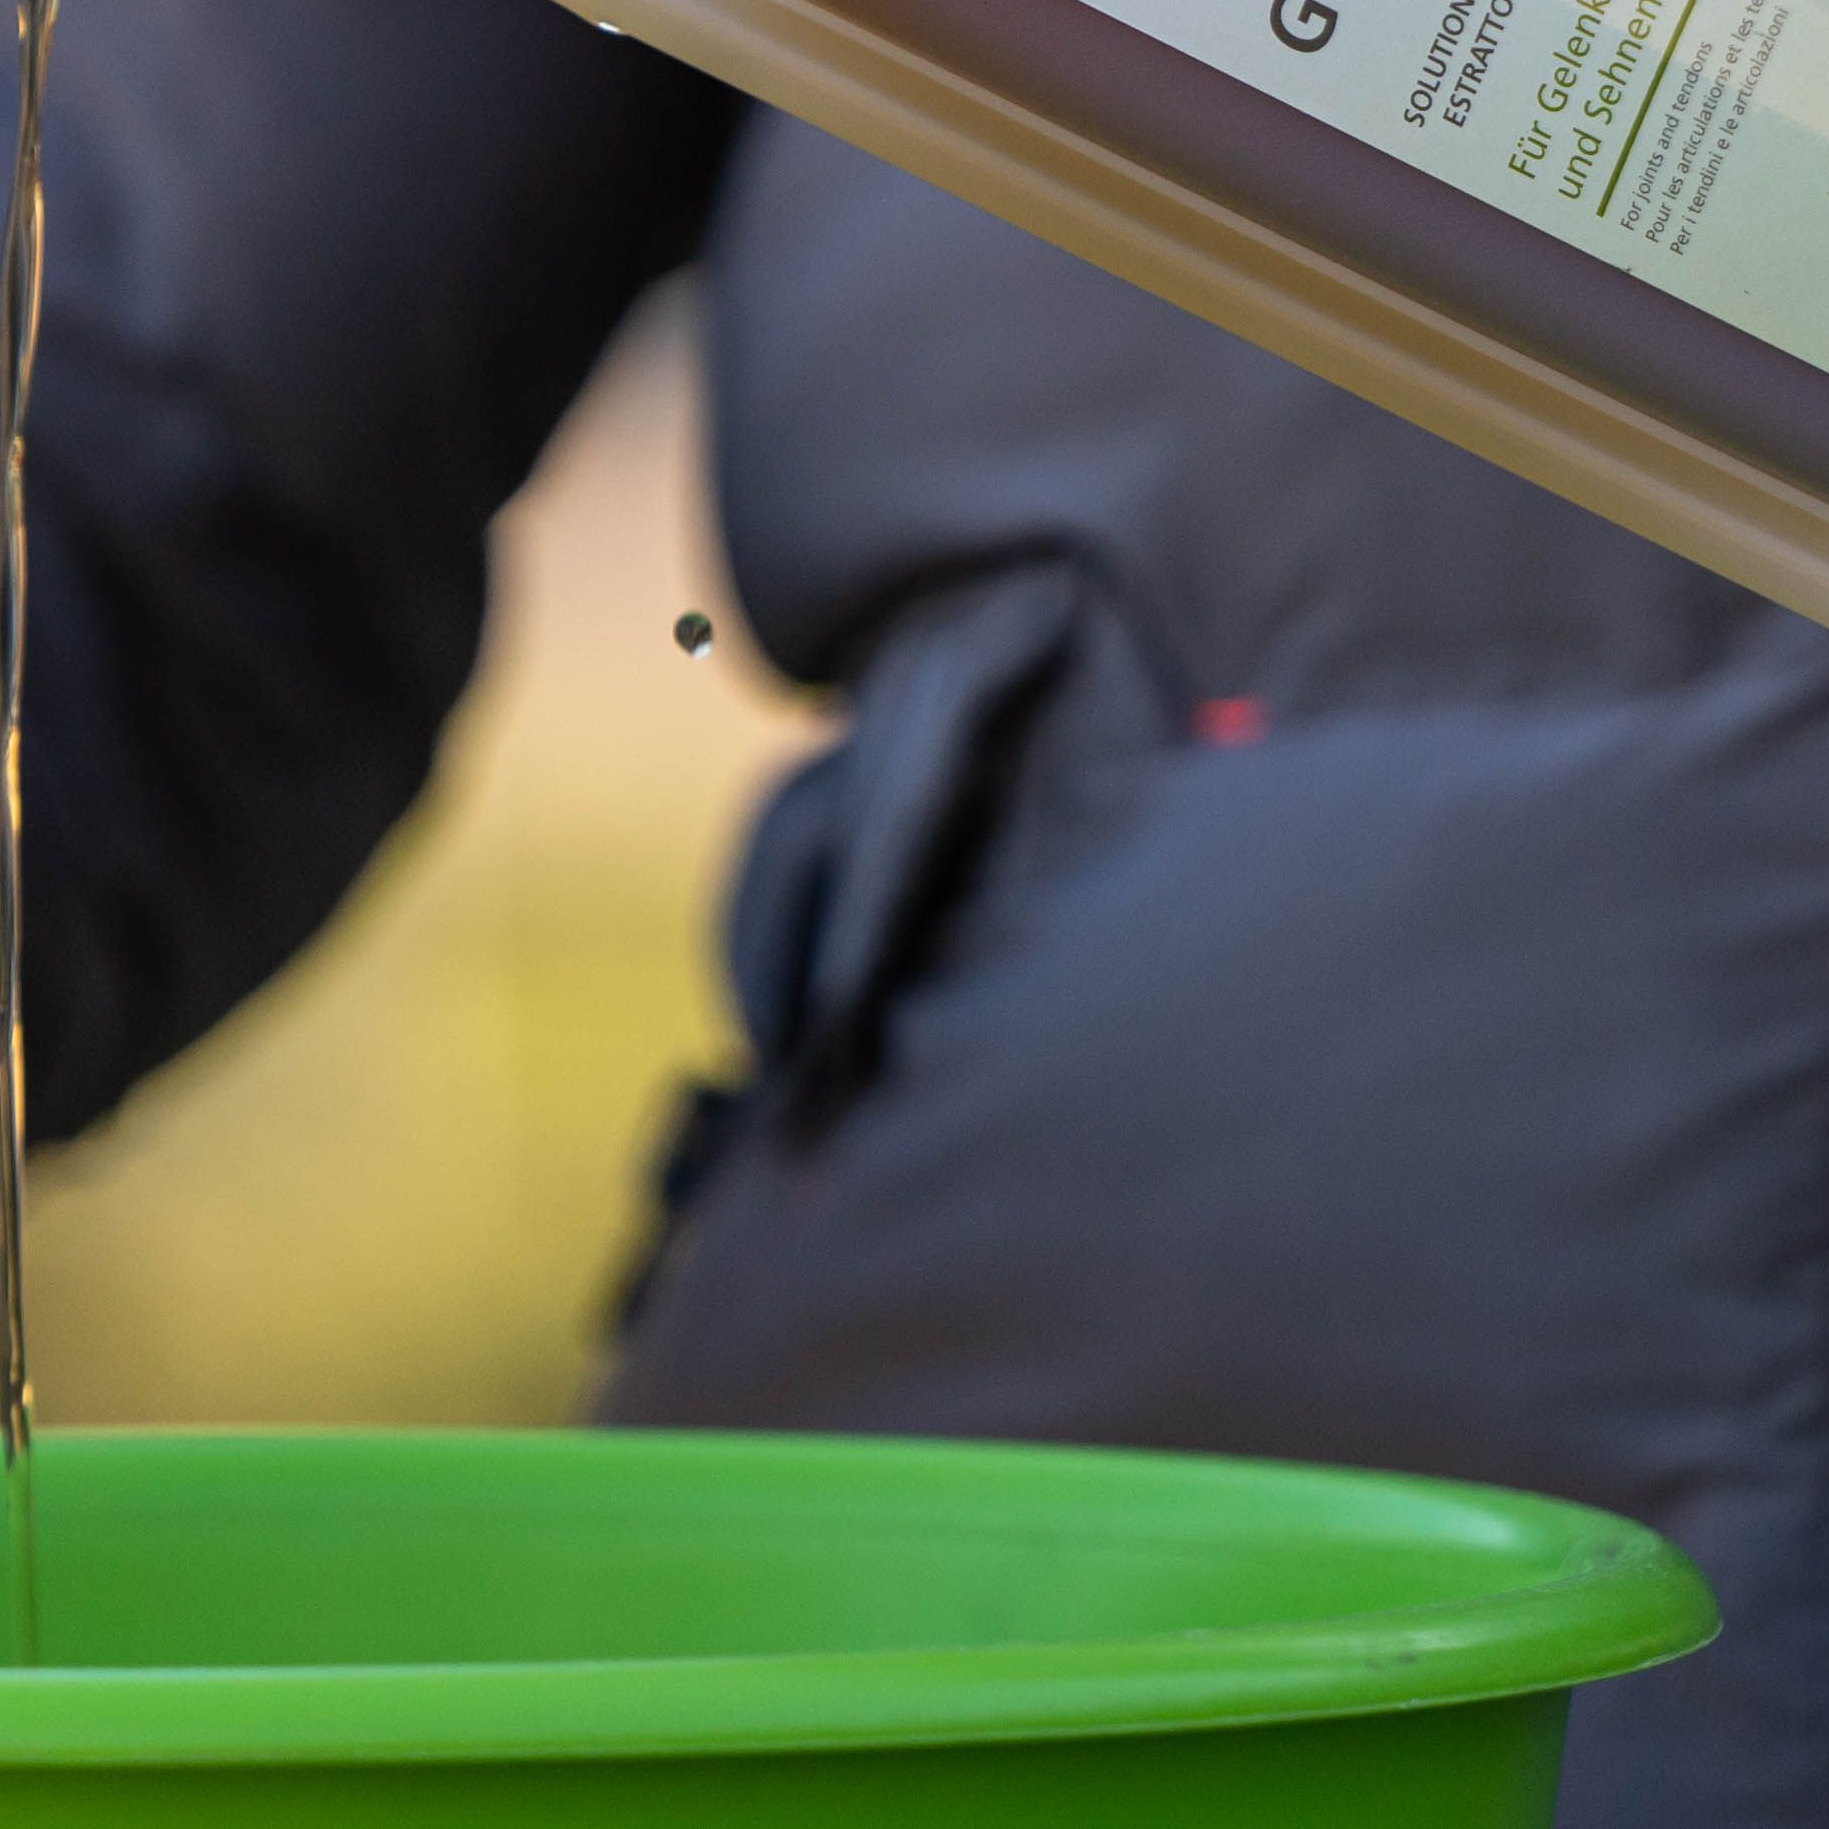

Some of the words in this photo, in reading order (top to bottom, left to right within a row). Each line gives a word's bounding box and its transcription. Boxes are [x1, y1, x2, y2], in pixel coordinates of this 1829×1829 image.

[1730, 18, 1754, 42] les
[1725, 44, 1743, 64] et
[1732, 8, 1789, 116] articolazioni
[1620, 201, 1642, 231] For
[1636, 152, 1664, 204] joints
[1658, 114, 1680, 150] and
[1671, 44, 1712, 112] tendons
[1677, 70, 1731, 174] articulations
[1719, 118, 1739, 136] le
[1508, 120, 1552, 179] Für
[1717, 139, 1730, 150] e
[1558, 127, 1602, 199] und
[1662, 176, 1684, 200] les
[1687, 151, 1724, 214] tendini
[1645, 202, 1672, 243] Pour
[1682, 215, 1697, 224] i
[1669, 226, 1692, 256] Per
